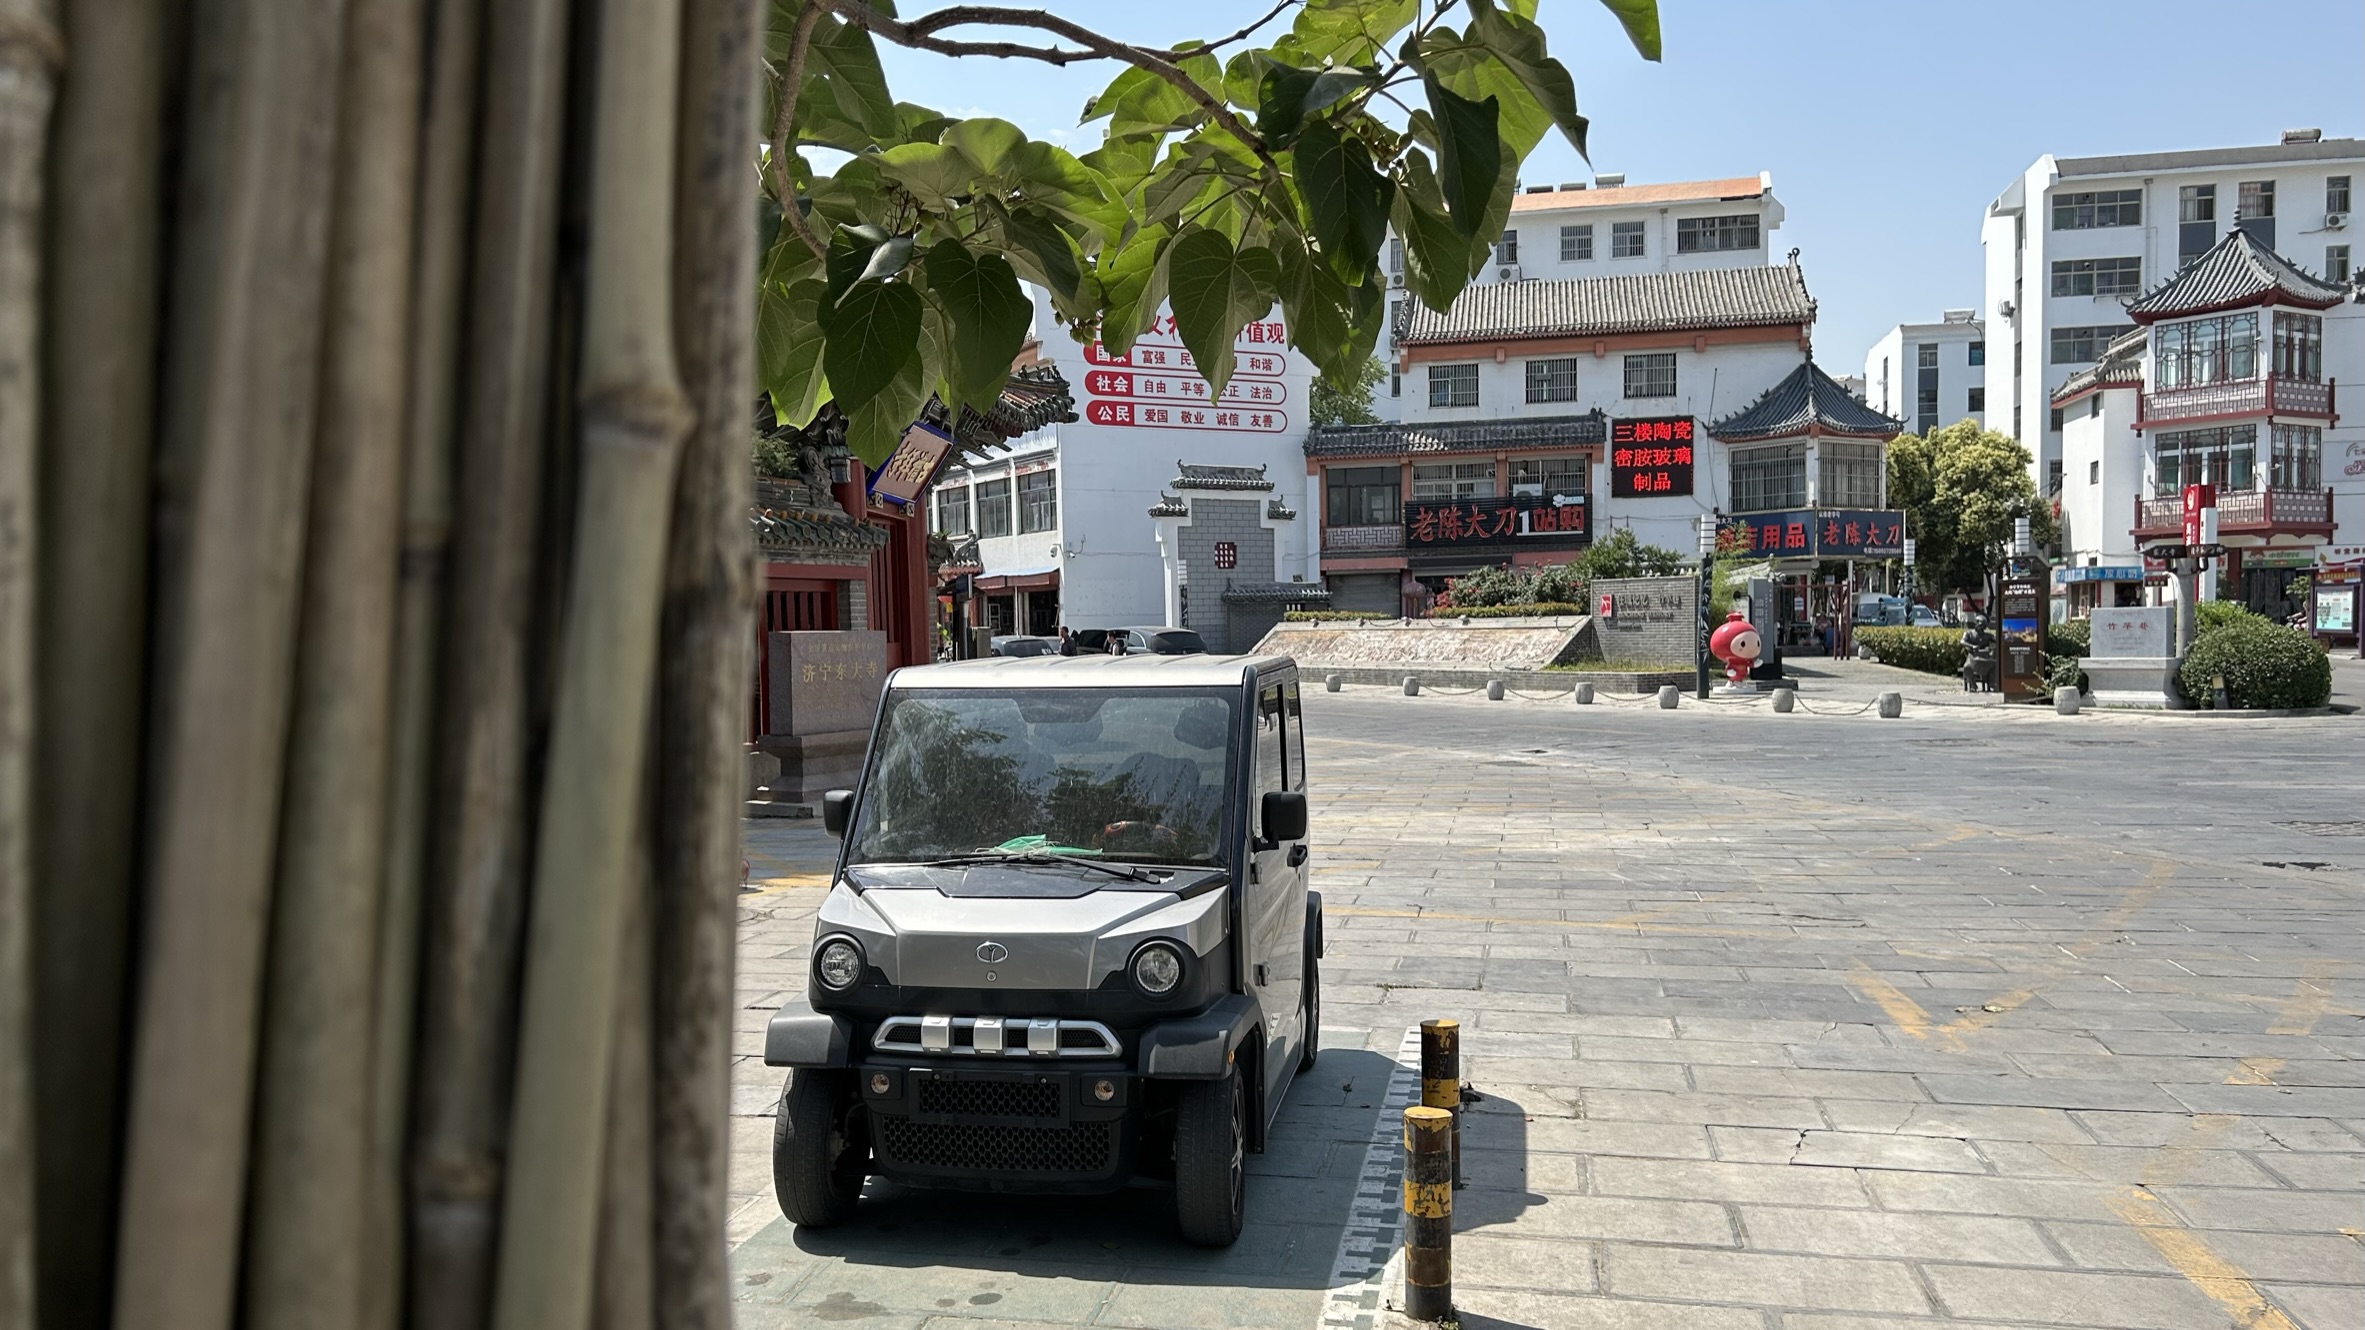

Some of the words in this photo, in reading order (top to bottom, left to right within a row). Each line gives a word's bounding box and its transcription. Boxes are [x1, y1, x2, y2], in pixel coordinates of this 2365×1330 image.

[1142, 349, 1166, 365] 富强
[1181, 353, 1196, 366] 民
[1249, 357, 1273, 371] 和谐
[1097, 375, 1128, 393] 社会
[1144, 379, 1167, 394] 自由
[1181, 382, 1205, 397] 平等
[1250, 386, 1273, 400] 法治
[1098, 405, 1130, 422] 公民
[1145, 409, 1168, 423] 爱国
[1181, 411, 1205, 425] 敬业
[1216, 412, 1240, 427] 诚信
[1250, 414, 1273, 428] 友善
[1615, 421, 1692, 442] 三楼陶瓷
[1614, 445, 1692, 468] 密胺玻璃
[1633, 472, 1671, 492] 制品
[1823, 520, 1901, 546] 老陈大刀
[802, 661, 878, 683] 济宁东大寺
